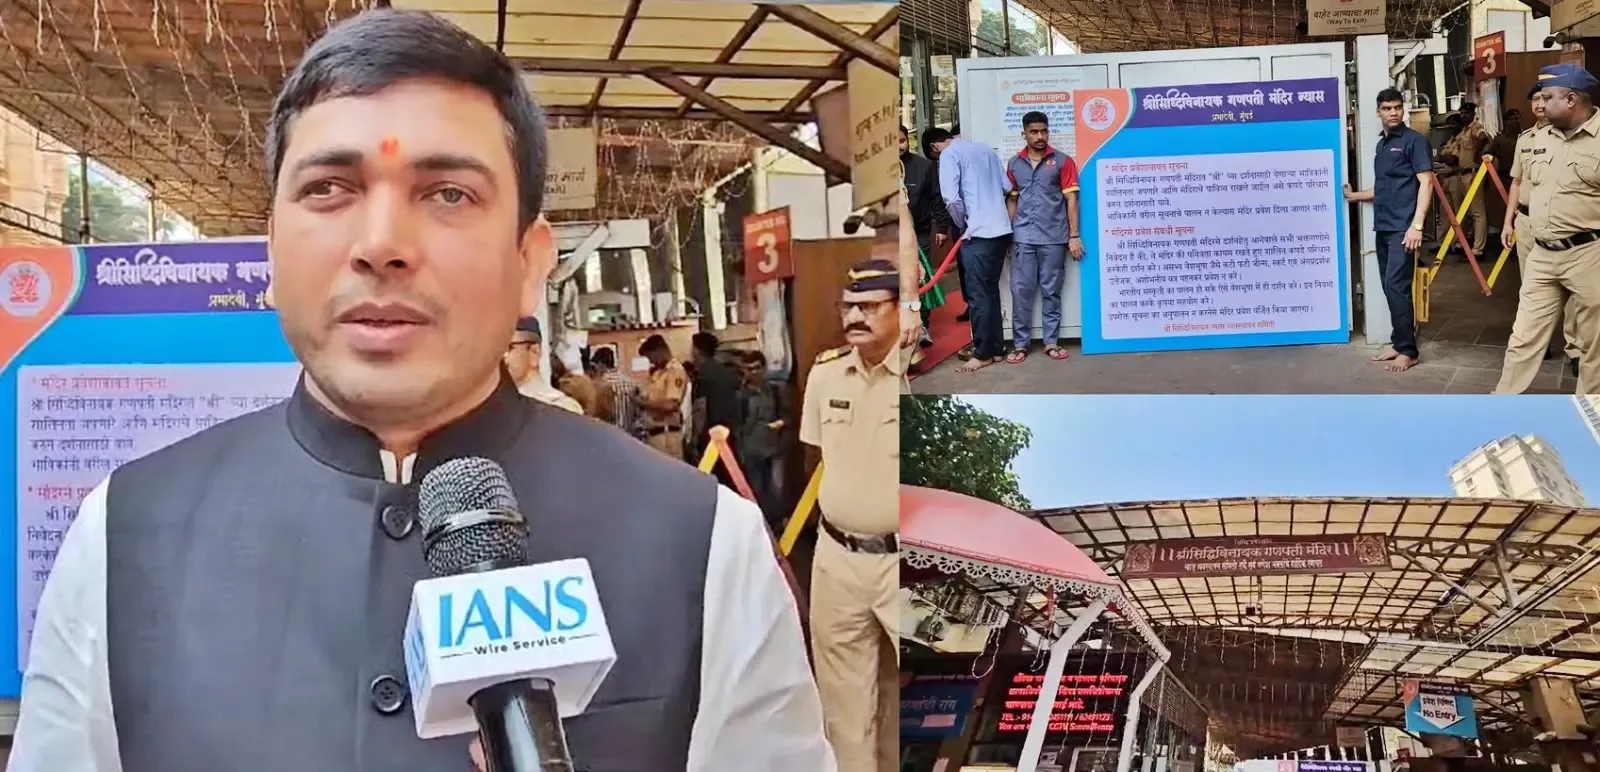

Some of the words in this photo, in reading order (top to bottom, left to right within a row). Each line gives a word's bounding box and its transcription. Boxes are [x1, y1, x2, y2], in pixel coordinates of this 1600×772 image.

[1326, 18, 1342, 26] (Way
[1482, 48, 1496, 75] 3
[1227, 89, 1264, 107] गणपती
[1269, 88, 1294, 106] मंदिर
[1297, 90, 1326, 103] न्यास
[1111, 162, 1128, 173] मंदिर
[1168, 162, 1188, 173] सूचना
[1105, 176, 1114, 185] श्री
[1159, 173, 1182, 184] गणपती
[1162, 185, 1178, 195] आणि
[1184, 208, 1202, 217] पालन
[1204, 208, 1210, 217] न
[1237, 205, 1253, 215] मंदिर
[1255, 204, 1271, 215] प्रवेश
[1116, 240, 1125, 250] श्री
[1173, 237, 1197, 248] गणपती
[756, 232, 779, 273] 3
[1158, 250, 1174, 260] मंदिर
[1166, 286, 1175, 295] का
[1151, 311, 1160, 319] का
[1219, 306, 1234, 316] मंदिर
[45, 506, 59, 521] श्री
[1264, 542, 1303, 557] गणपती
[1305, 541, 1332, 556] मंदिर
[439, 576, 588, 649] IANS
[473, 642, 509, 656] Wire
[512, 634, 567, 650] Service
[1423, 709, 1435, 718] No
[1435, 710, 1457, 722] Entry
